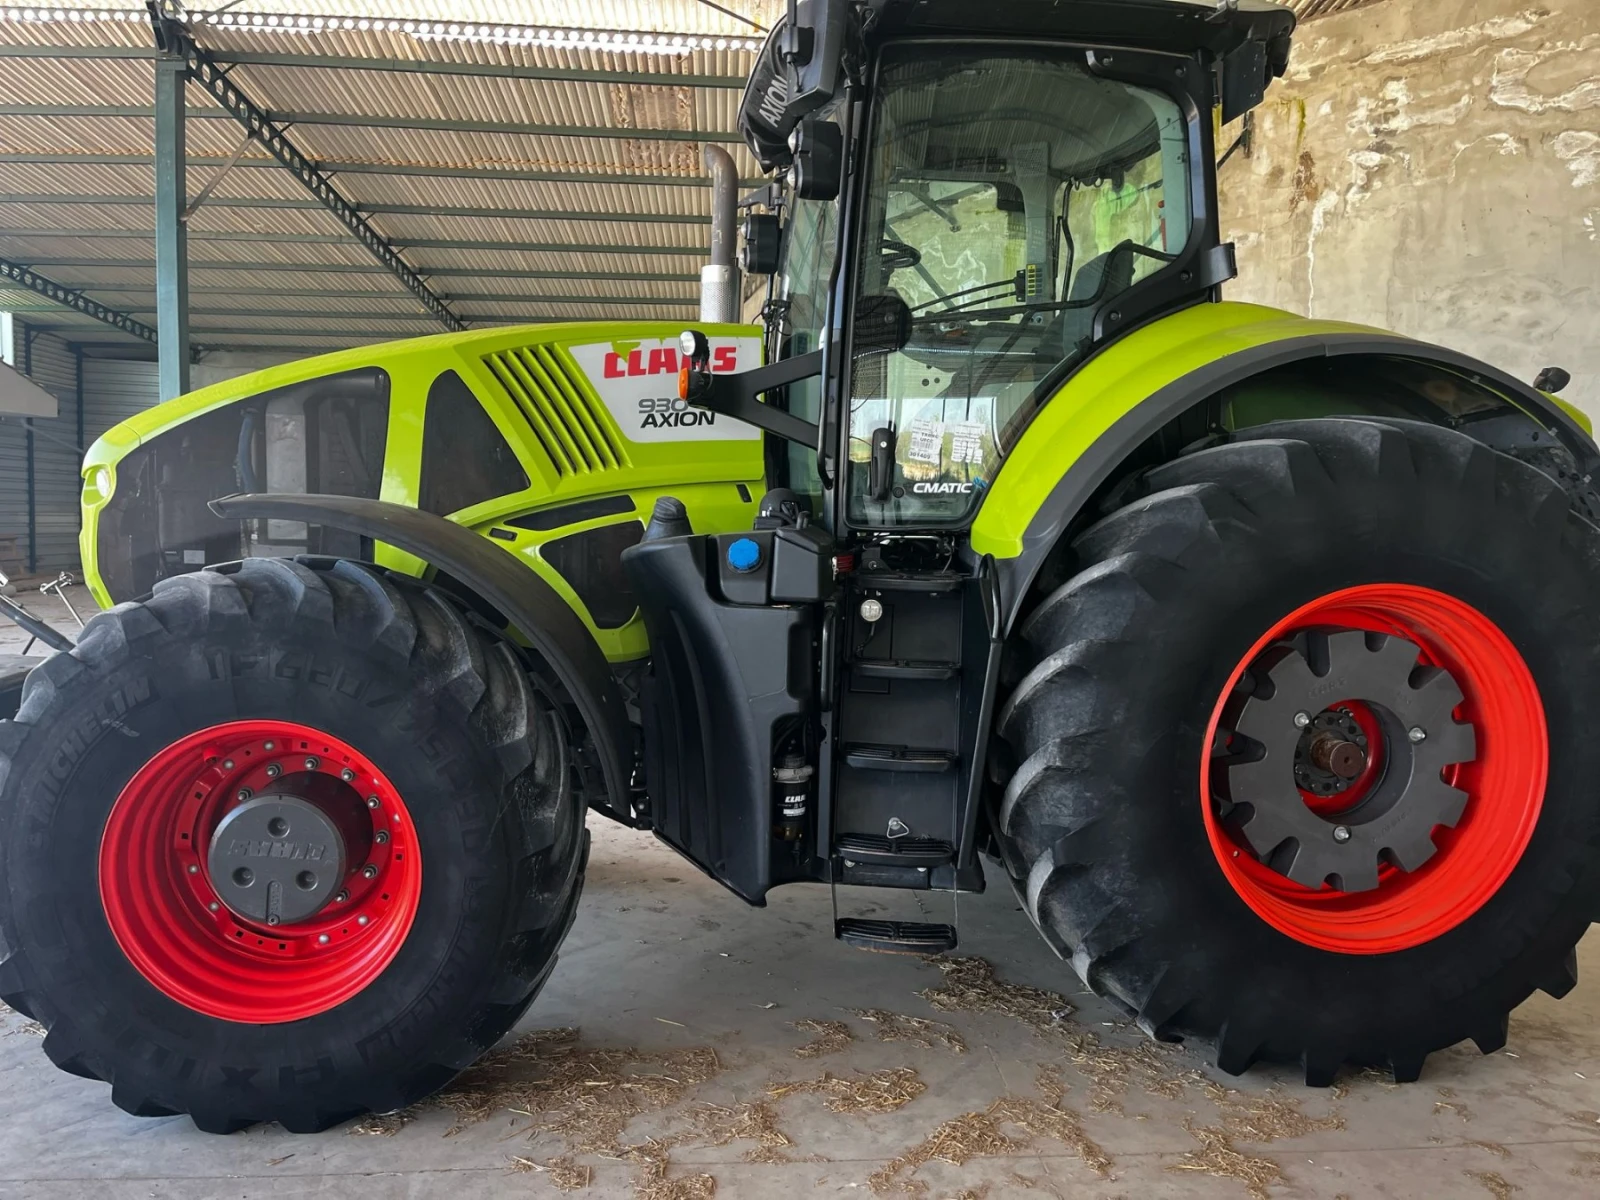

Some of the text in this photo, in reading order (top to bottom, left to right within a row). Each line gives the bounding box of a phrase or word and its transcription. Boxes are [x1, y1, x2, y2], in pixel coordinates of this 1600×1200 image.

[759, 74, 788, 128] AXION
[639, 398, 689, 414] 930
[640, 411, 715, 429] AXION
[913, 482, 972, 494] CMATIC
